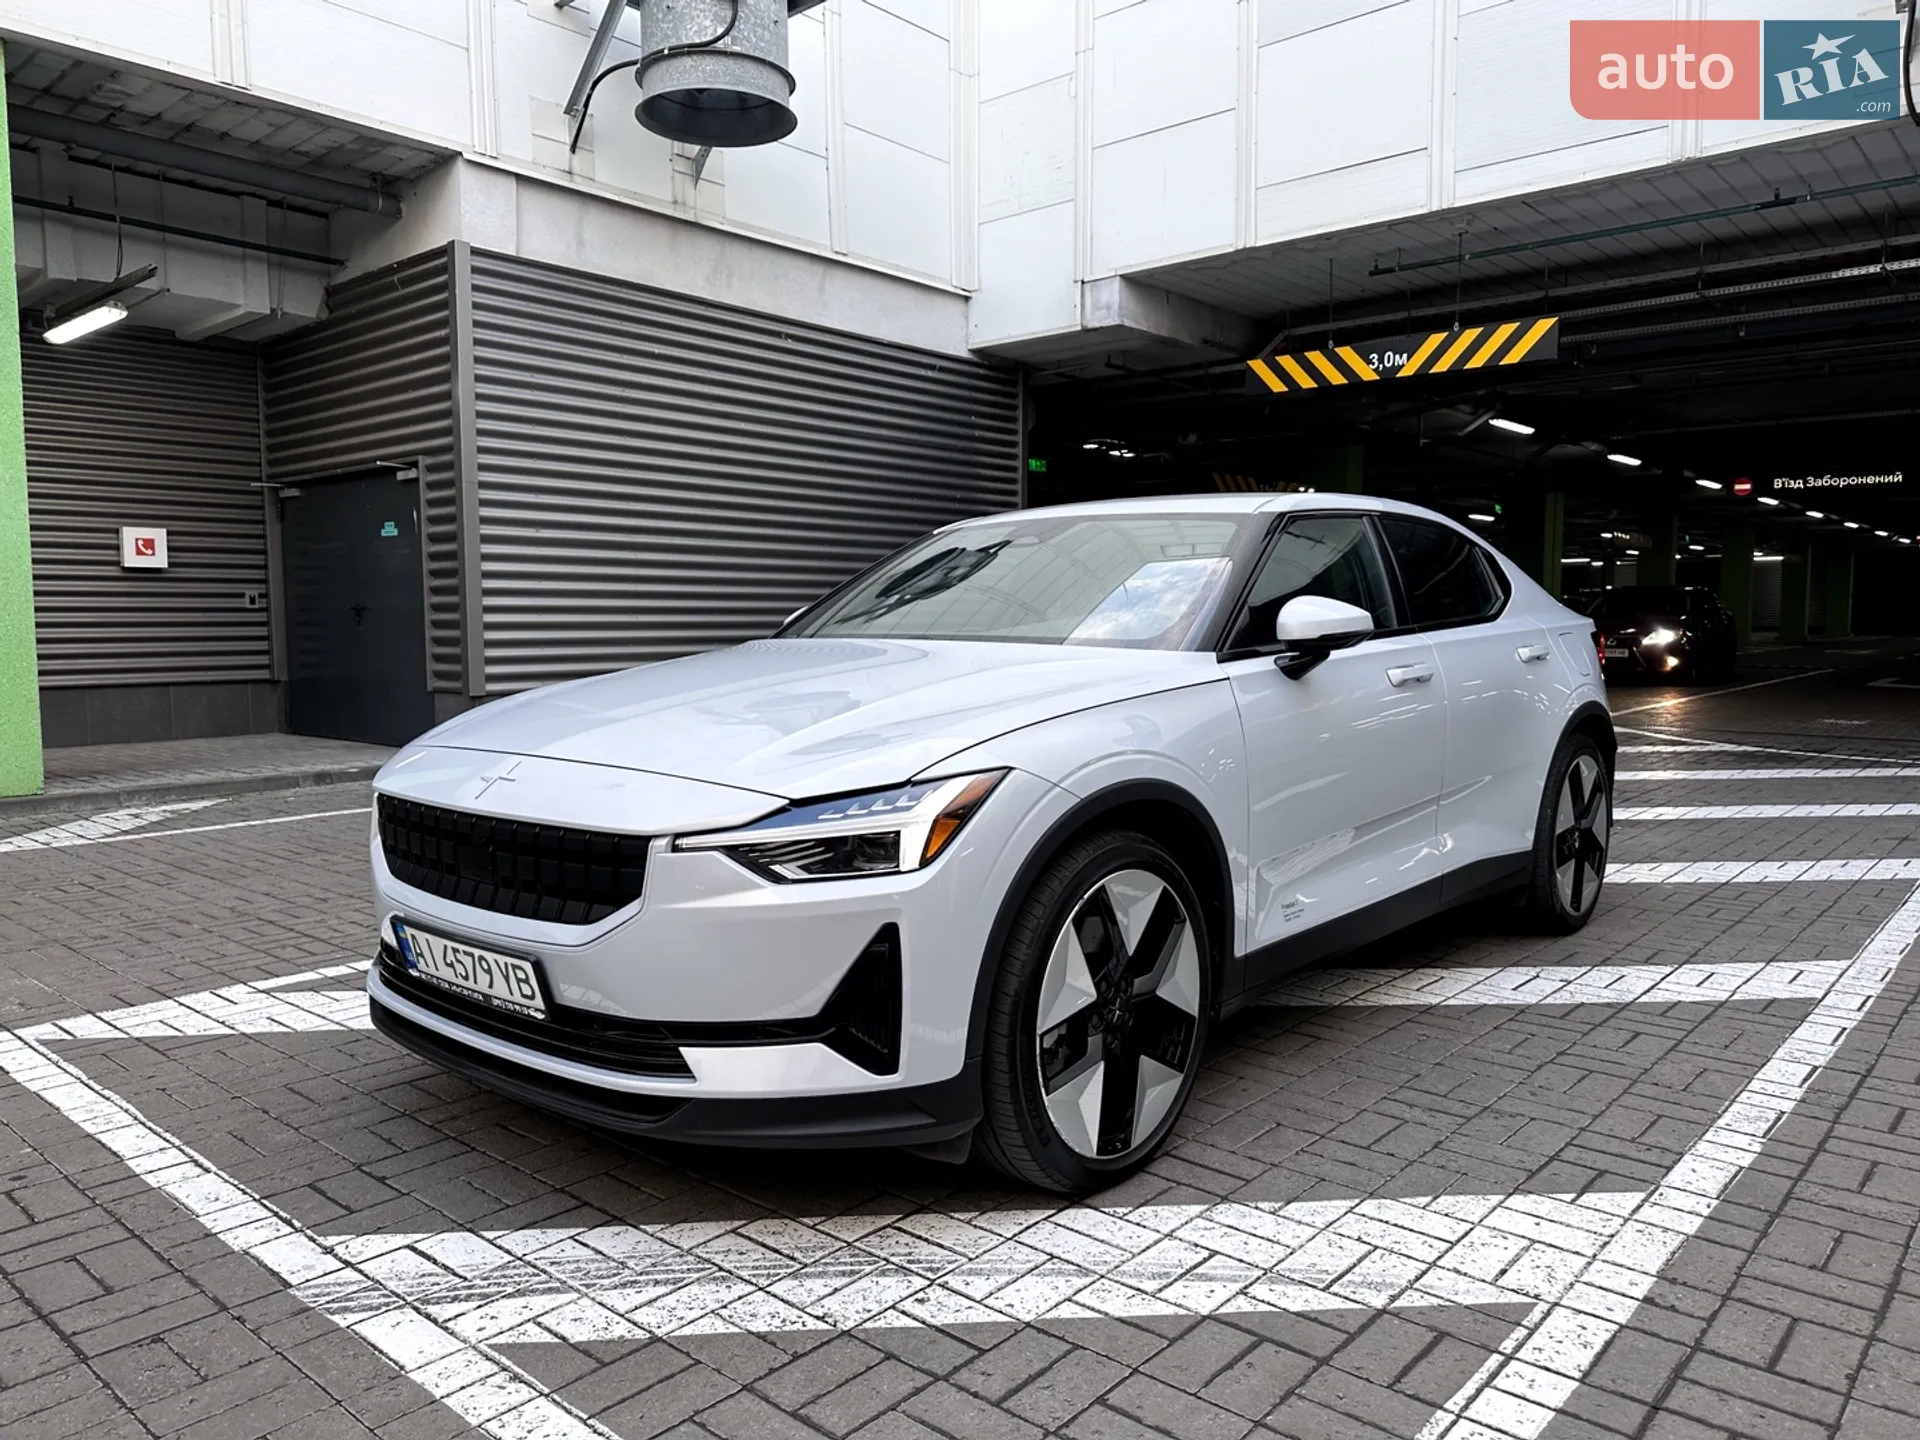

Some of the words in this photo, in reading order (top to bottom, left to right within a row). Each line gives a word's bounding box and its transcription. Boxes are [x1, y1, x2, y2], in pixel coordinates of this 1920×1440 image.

[1368, 350, 1408, 372] 3,0м
[1806, 471, 1903, 488] Заборонений
[410, 932, 440, 972] AI
[442, 944, 494, 990] 4579
[493, 958, 536, 1001] YB
